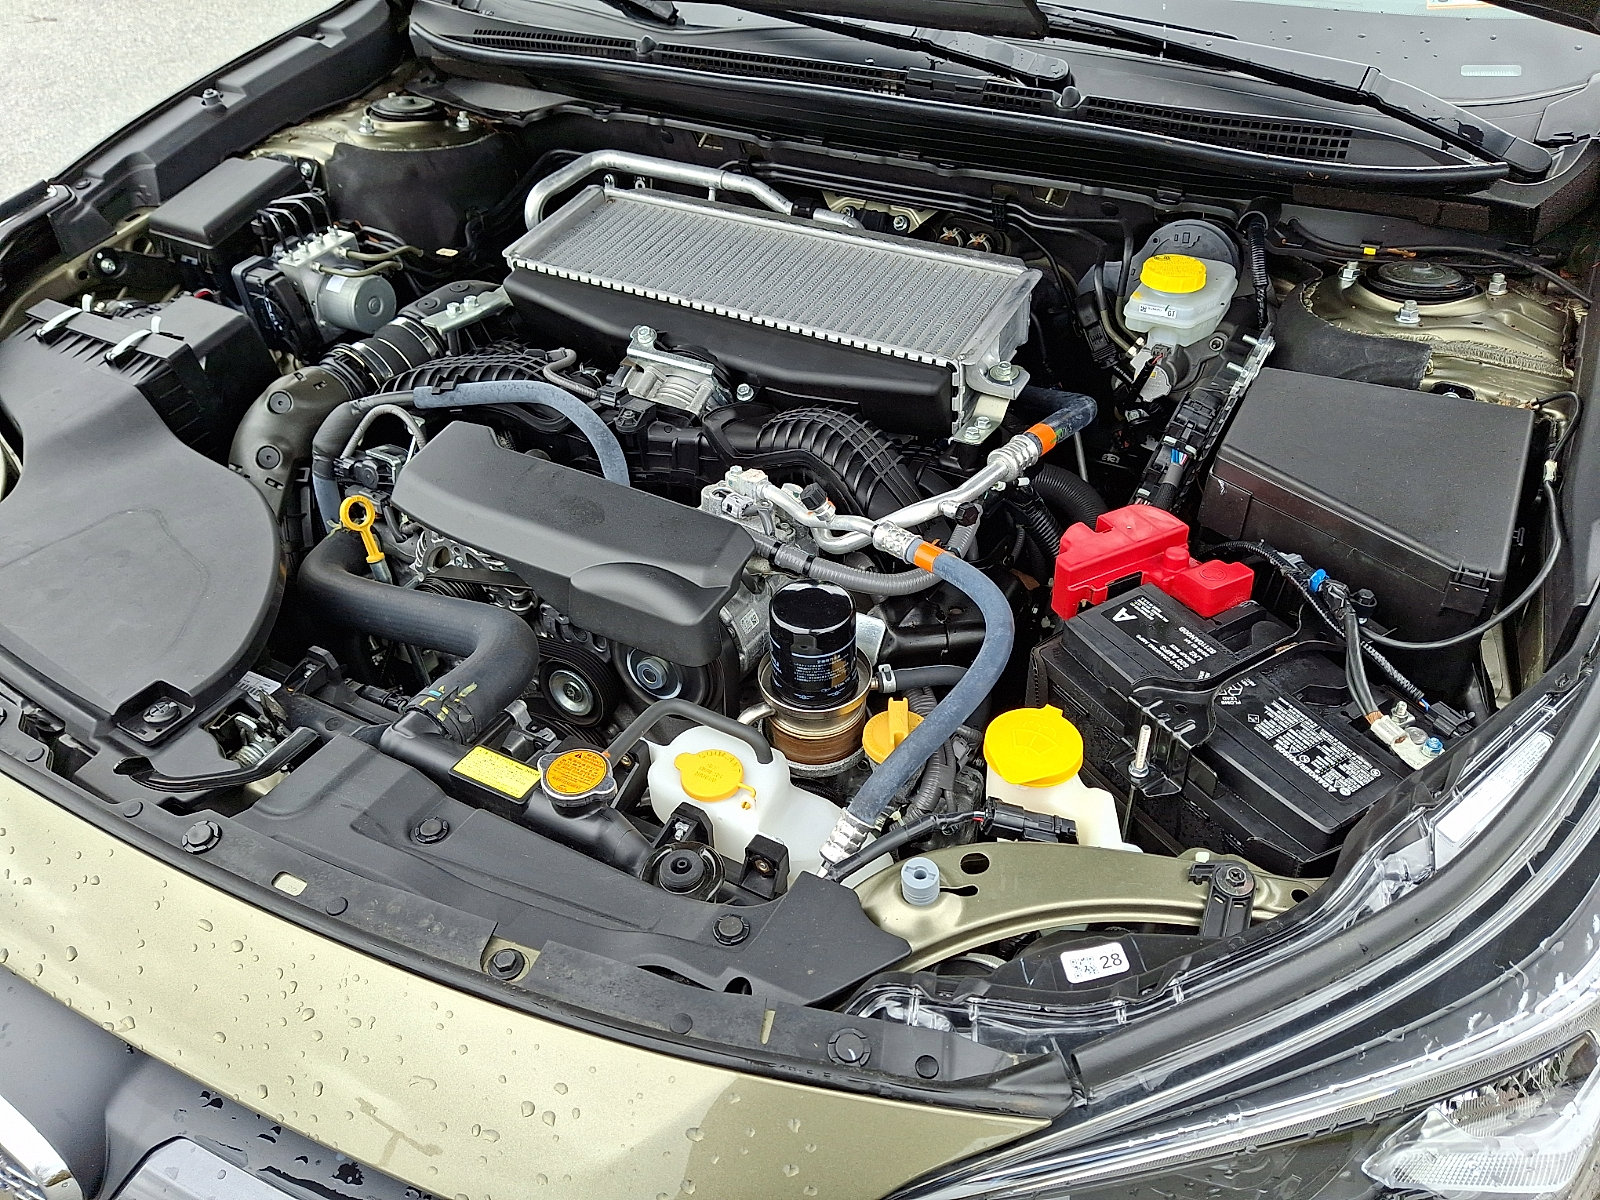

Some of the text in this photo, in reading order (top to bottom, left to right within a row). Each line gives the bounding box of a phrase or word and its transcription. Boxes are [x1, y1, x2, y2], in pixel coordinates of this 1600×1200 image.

[1112, 607, 1138, 622] A
[1136, 634, 1183, 670] COLD CRANKING AMPS
[1159, 645, 1179, 659] AMPS
[1273, 743, 1330, 788] DANGER/POISON
[1100, 953, 1122, 970] 28
